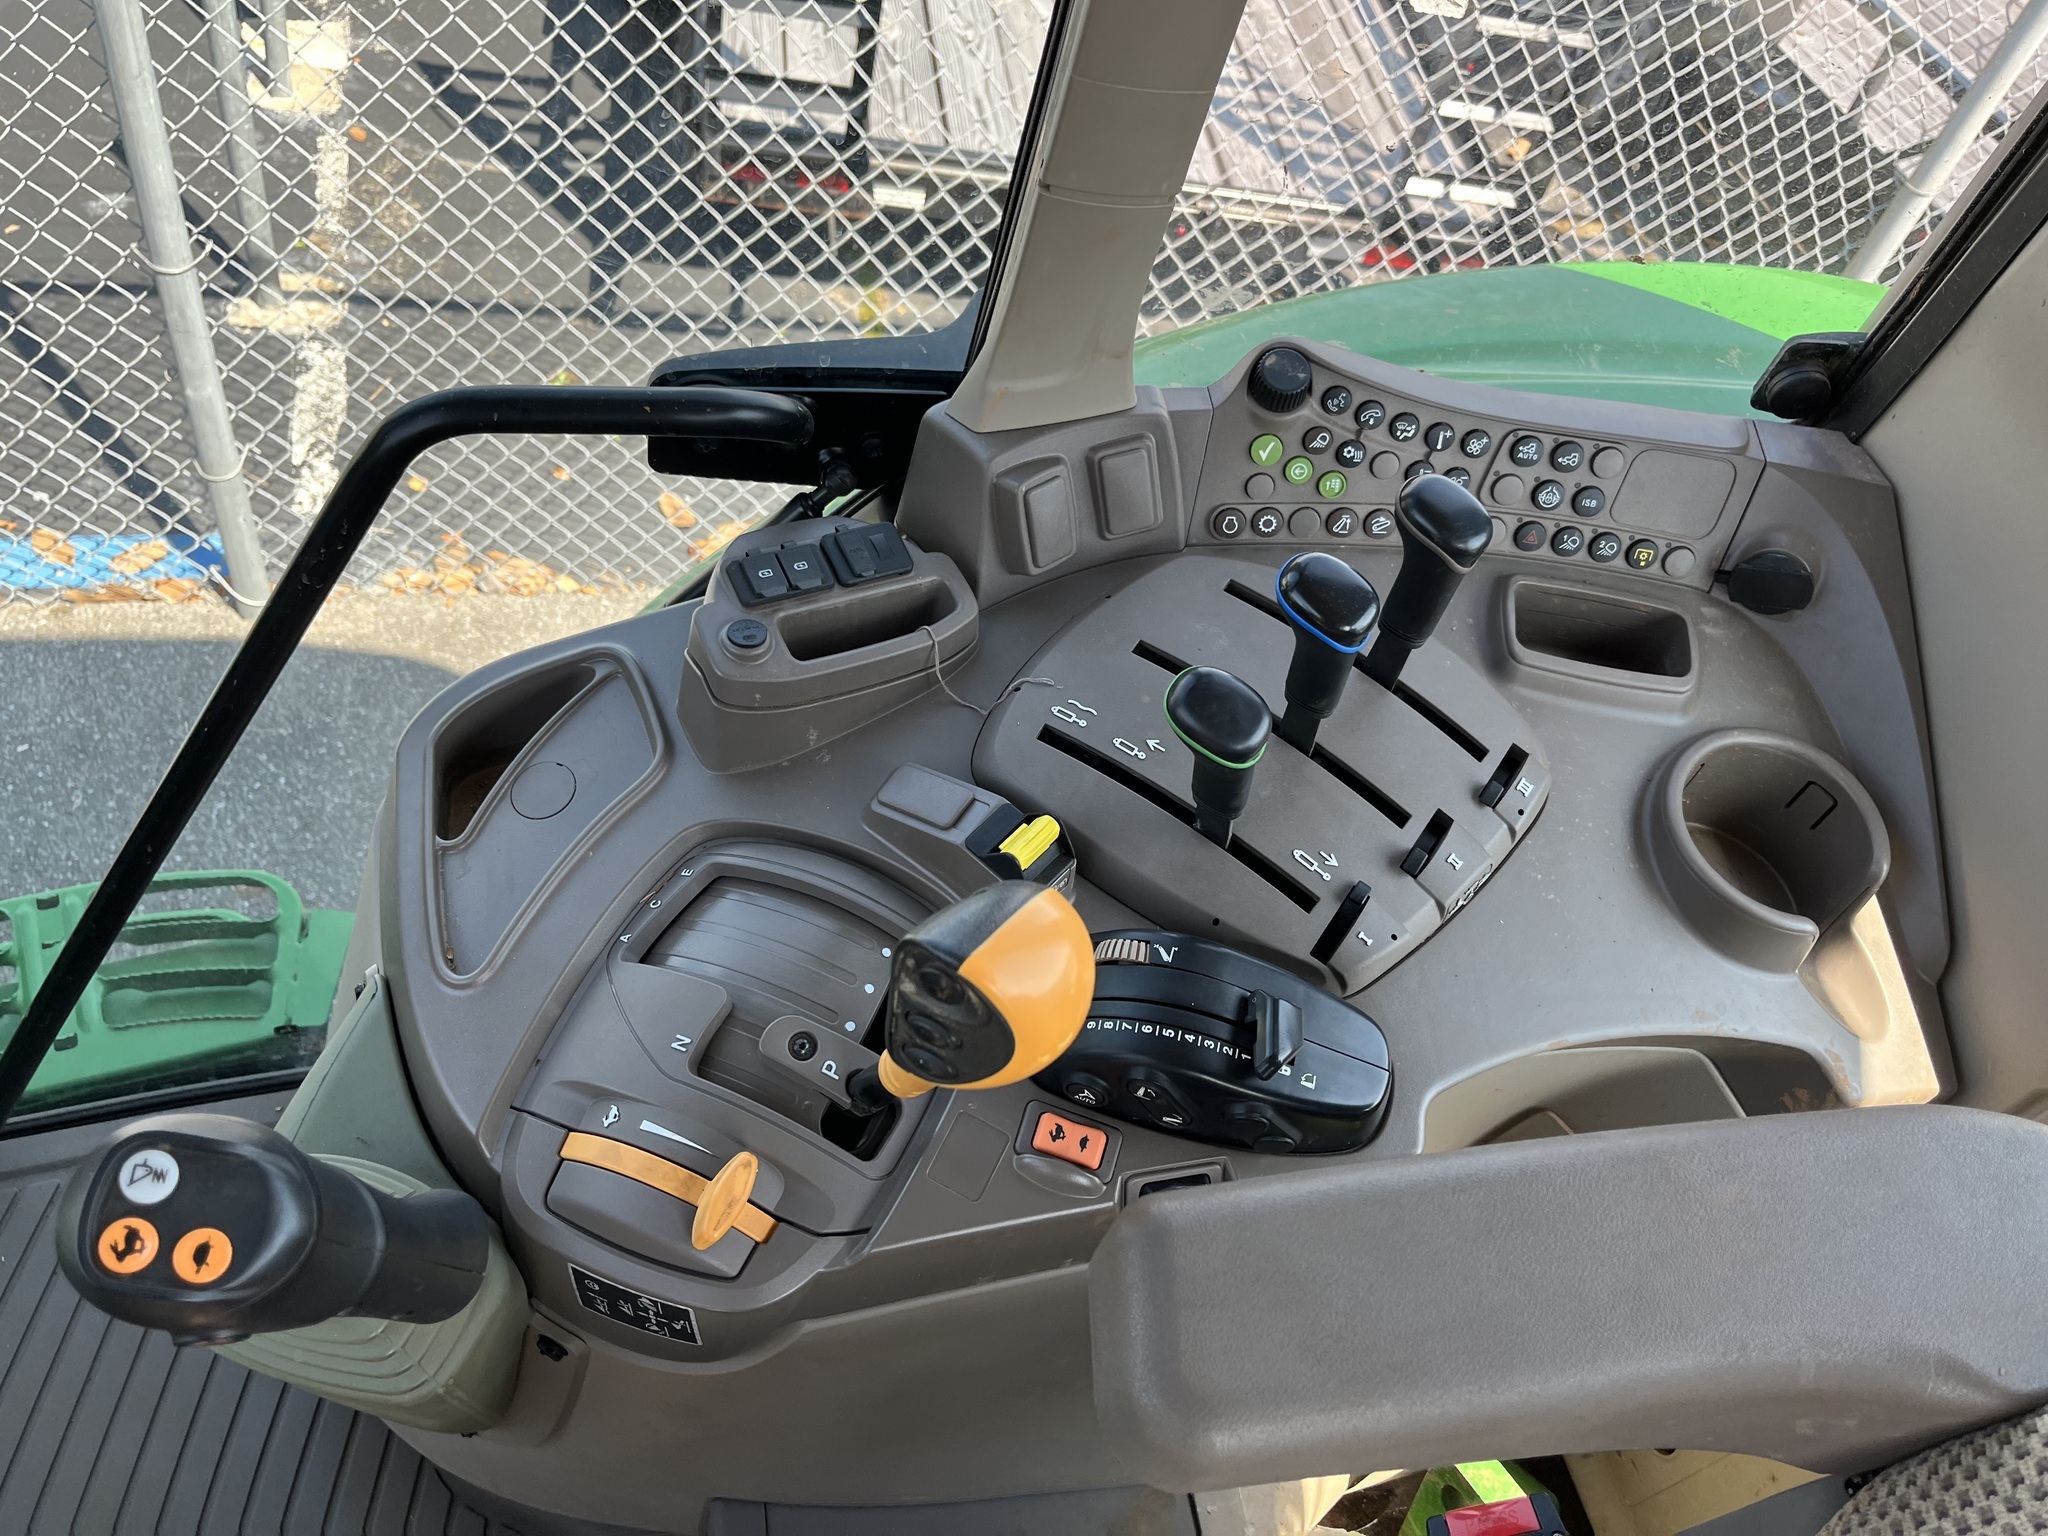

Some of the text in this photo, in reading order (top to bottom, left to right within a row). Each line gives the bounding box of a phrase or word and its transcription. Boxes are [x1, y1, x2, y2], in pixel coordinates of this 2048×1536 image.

[1517, 452, 1538, 461] AUTO
[1582, 499, 1597, 508] ISB
[680, 867, 695, 878] E
[650, 899, 662, 909] C
[619, 933, 632, 943] A
[670, 1034, 692, 1053] N
[1086, 1021, 1096, 1029] 9
[1103, 1021, 1113, 1029] 8
[1121, 1022, 1132, 1030] 7
[1141, 1025, 1153, 1033] 6
[1162, 1028, 1175, 1038] 5
[1184, 1033, 1196, 1043] 4
[1203, 1039, 1215, 1049] 3
[1222, 1046, 1233, 1056] 2
[821, 1059, 840, 1080] P
[1074, 1095, 1096, 1105] AUTO
